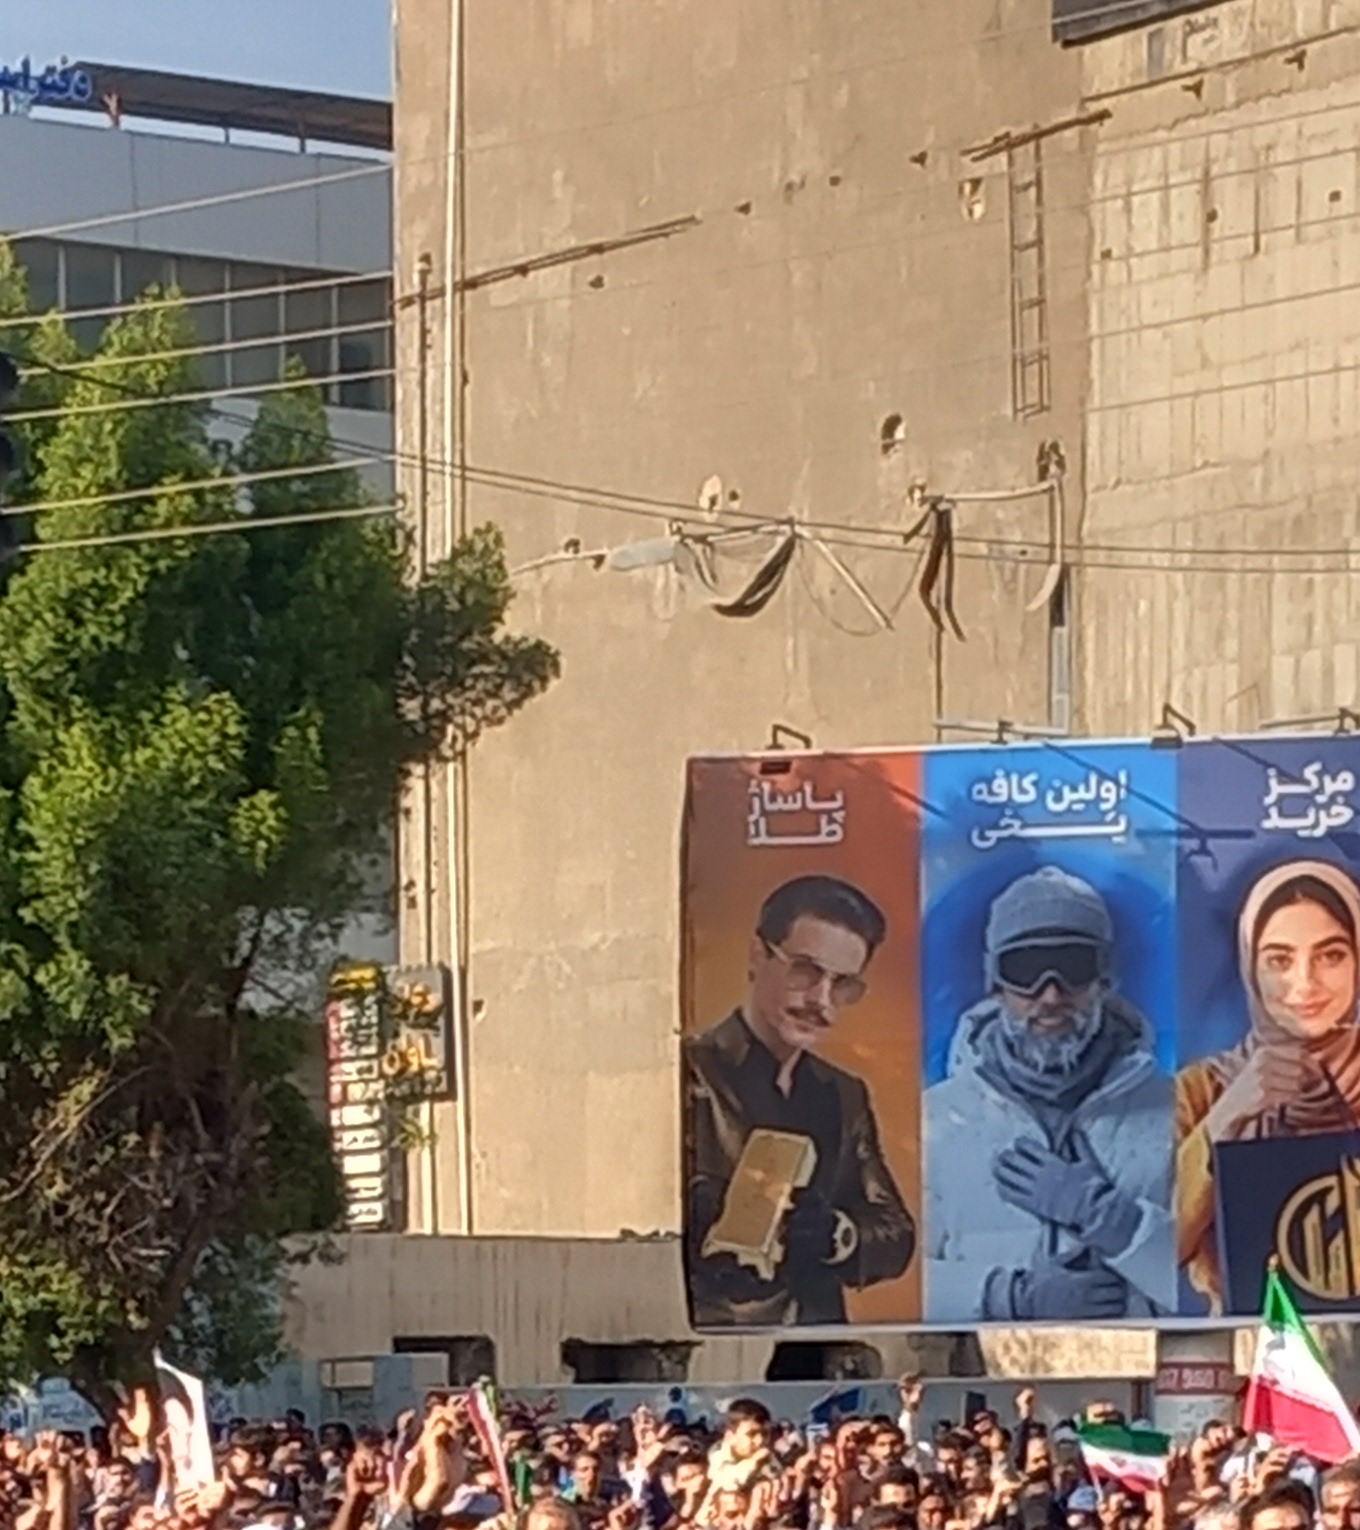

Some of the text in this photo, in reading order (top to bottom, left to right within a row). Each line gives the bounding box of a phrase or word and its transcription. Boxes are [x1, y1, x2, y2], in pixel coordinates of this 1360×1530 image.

[747, 779, 844, 820] پاساژ
[971, 769, 1128, 812] اولین کافه
[1263, 761, 1356, 806] مرکز
[747, 815, 844, 847] طلا
[971, 808, 1128, 850] یخی
[1260, 796, 1355, 838] خرید
